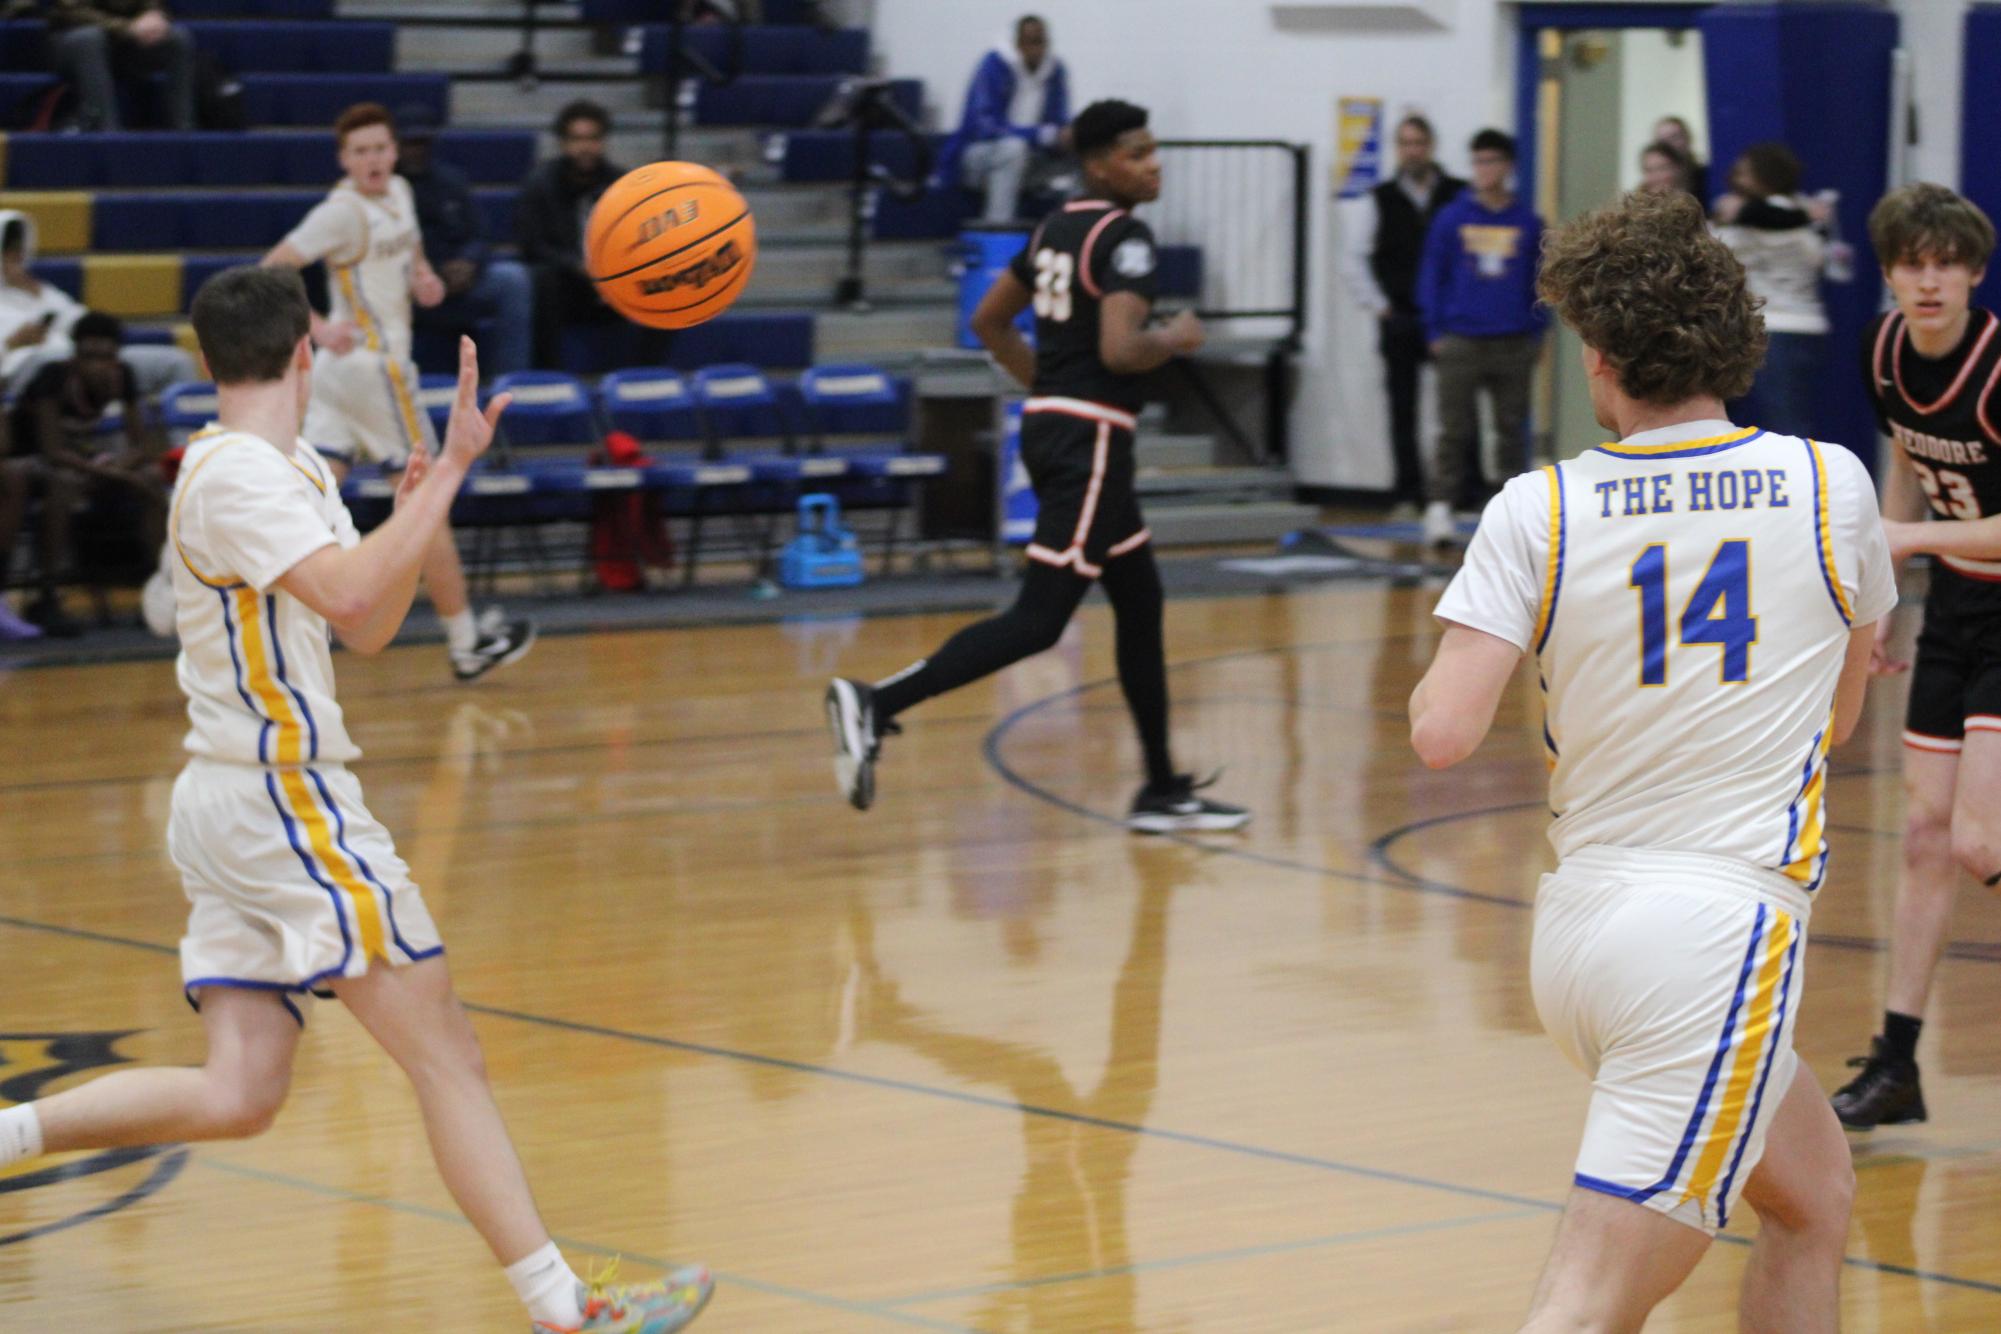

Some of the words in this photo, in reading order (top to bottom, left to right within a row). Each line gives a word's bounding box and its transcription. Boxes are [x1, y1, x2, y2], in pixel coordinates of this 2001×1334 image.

[1594, 472, 1674, 518] THE
[1687, 469, 1790, 512] HOPE
[1911, 460, 1982, 521] 23
[1628, 537, 1760, 688] 14
